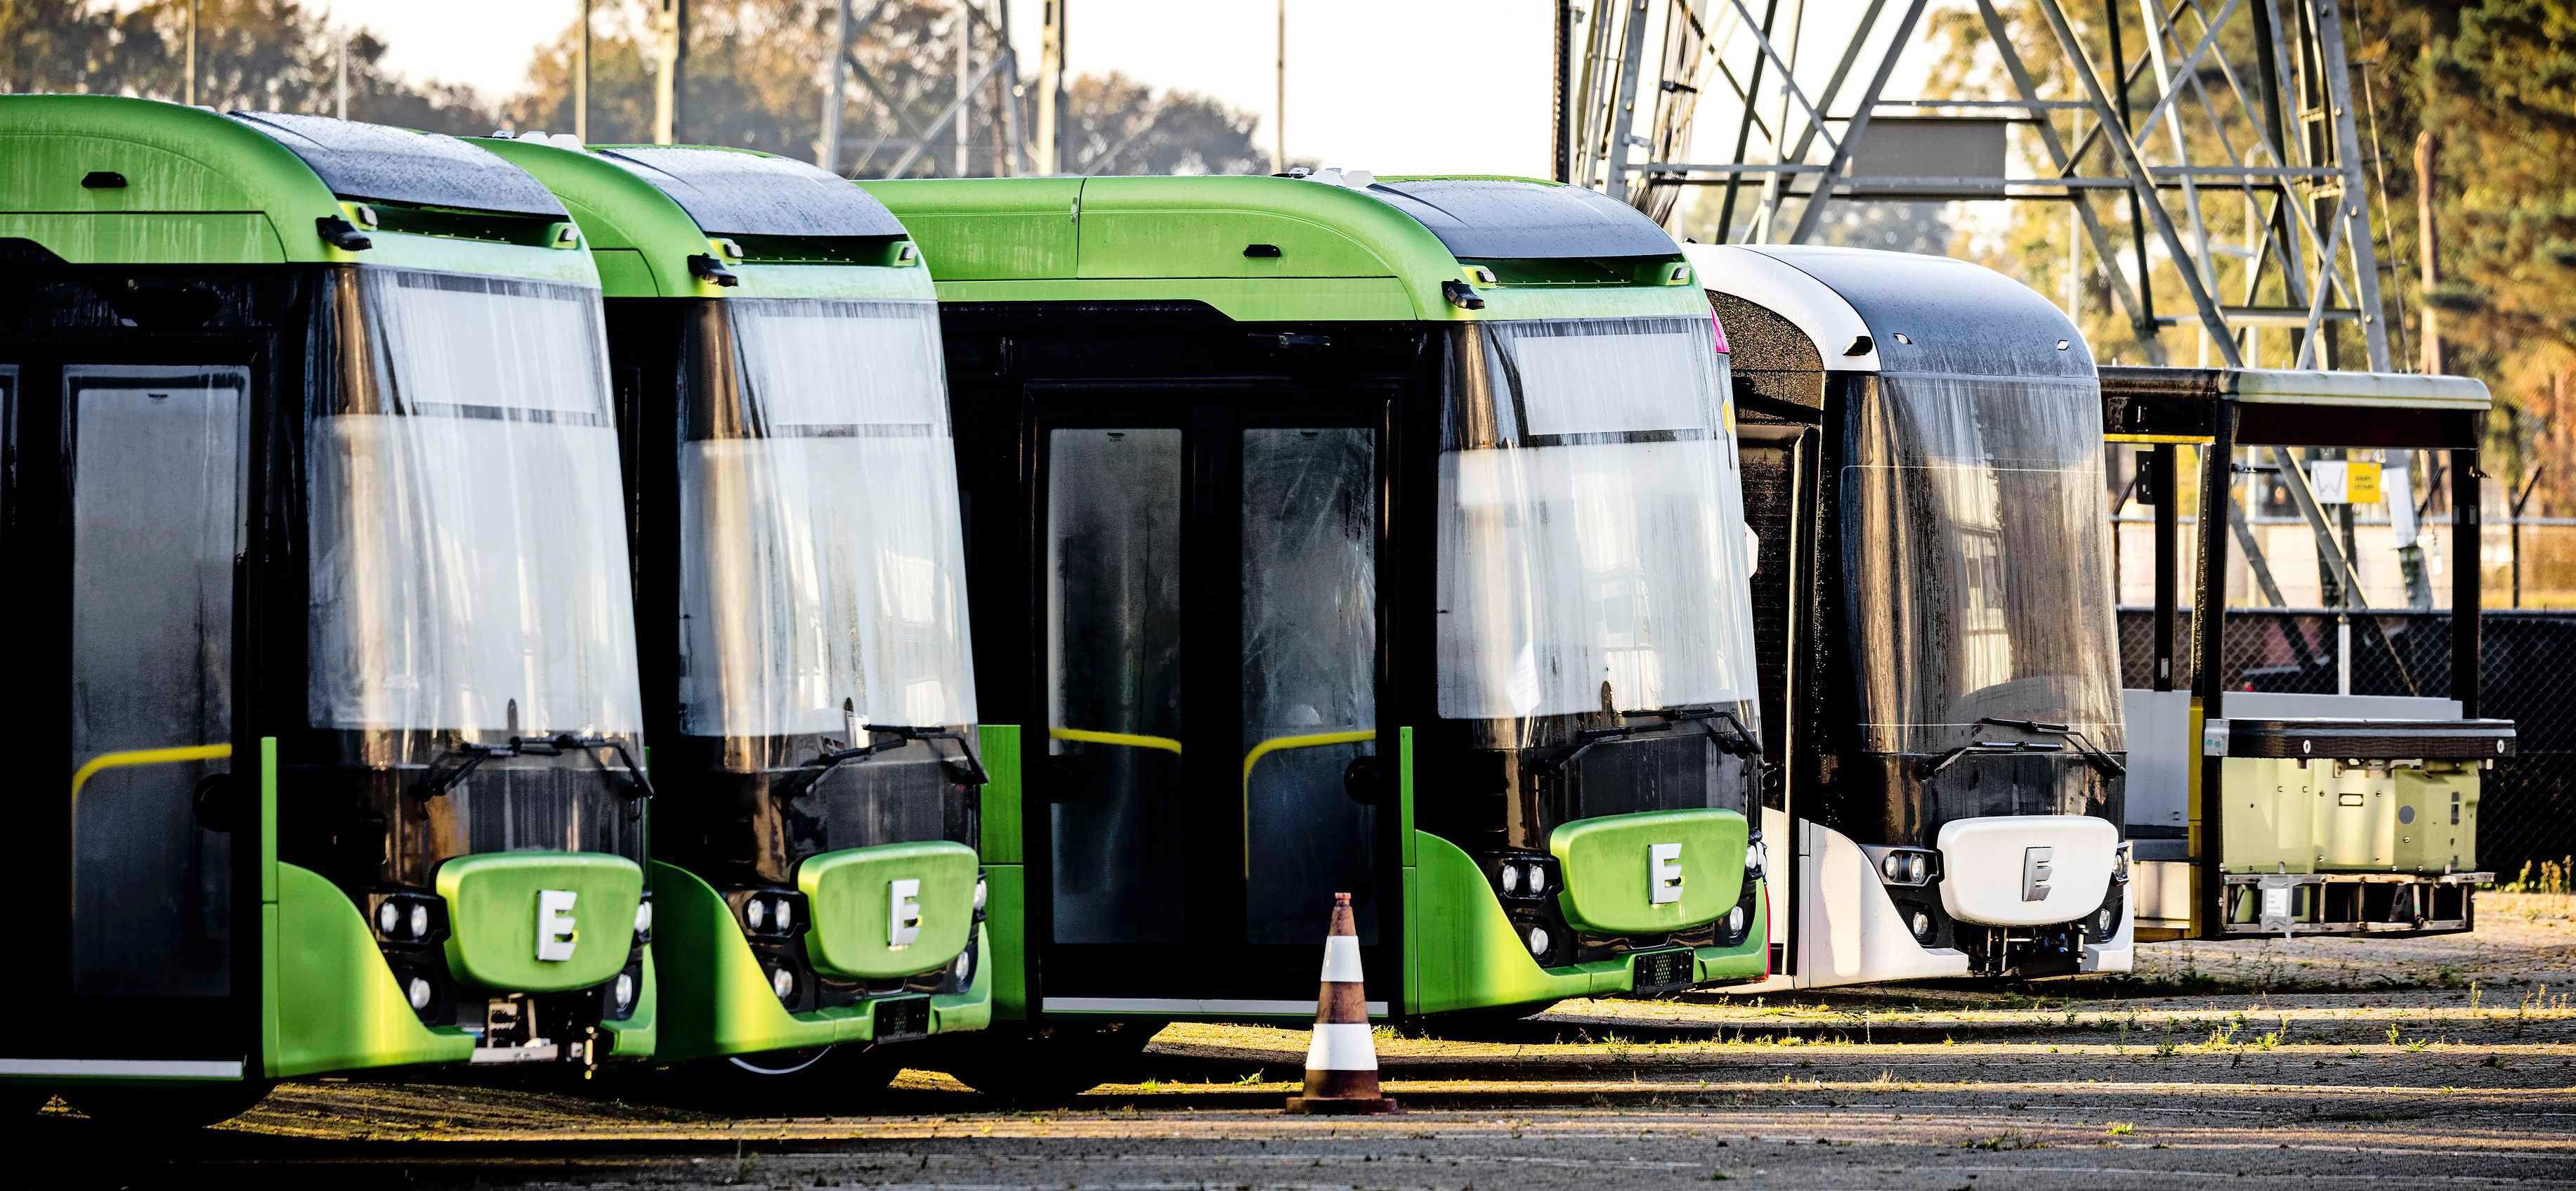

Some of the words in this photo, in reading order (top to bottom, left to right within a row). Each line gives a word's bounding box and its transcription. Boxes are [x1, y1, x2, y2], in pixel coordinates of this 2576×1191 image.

[1647, 842, 1682, 904] E
[2022, 846, 2053, 902] E
[536, 890, 577, 961] E
[888, 879, 921, 946] E
